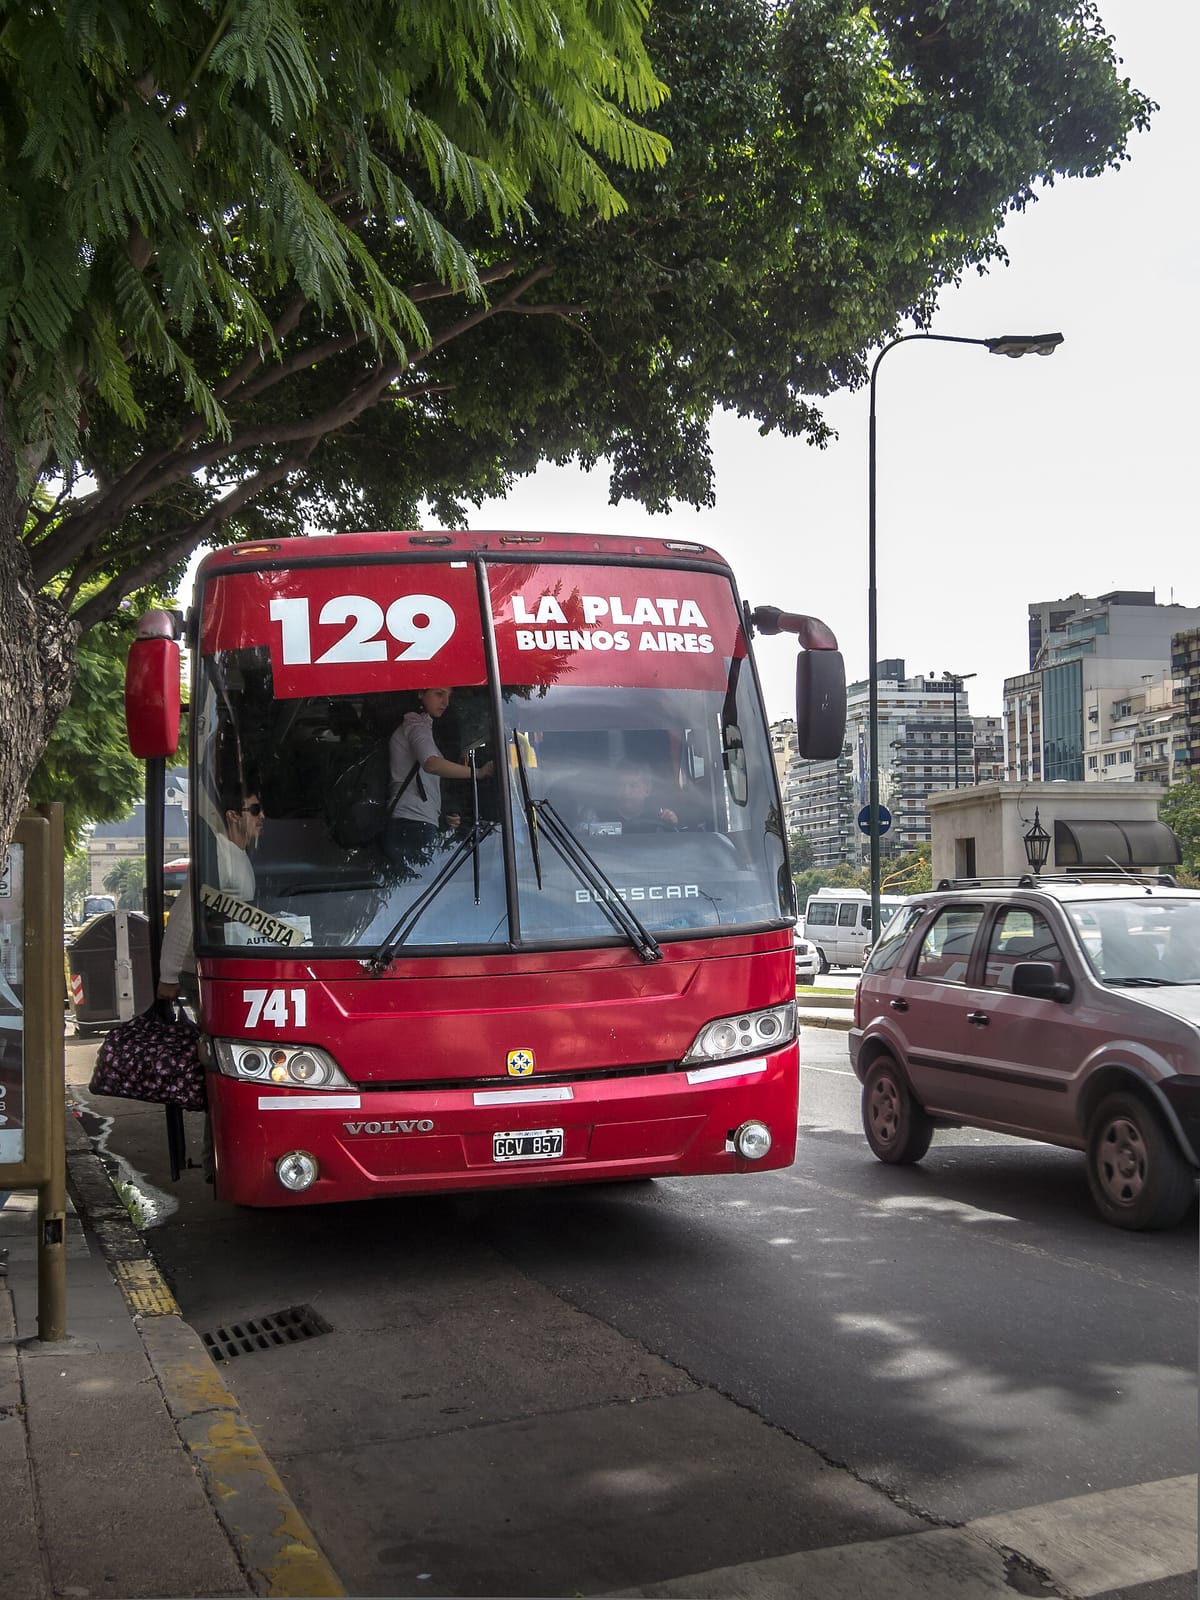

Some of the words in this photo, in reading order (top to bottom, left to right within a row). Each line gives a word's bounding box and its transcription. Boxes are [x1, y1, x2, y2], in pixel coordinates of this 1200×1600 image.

[511, 595, 568, 624] LA
[582, 595, 708, 628] PLATA
[270, 594, 456, 665] 129
[516, 630, 630, 651] BUENOS
[639, 631, 714, 653] AIRES
[575, 885, 699, 903] BUSSCAR
[210, 894, 294, 947] AUTOPISTA
[243, 989, 306, 1028] 741
[342, 1119, 434, 1135] VOLVO
[496, 1139, 523, 1155] GCV
[533, 1136, 560, 1153] 857
